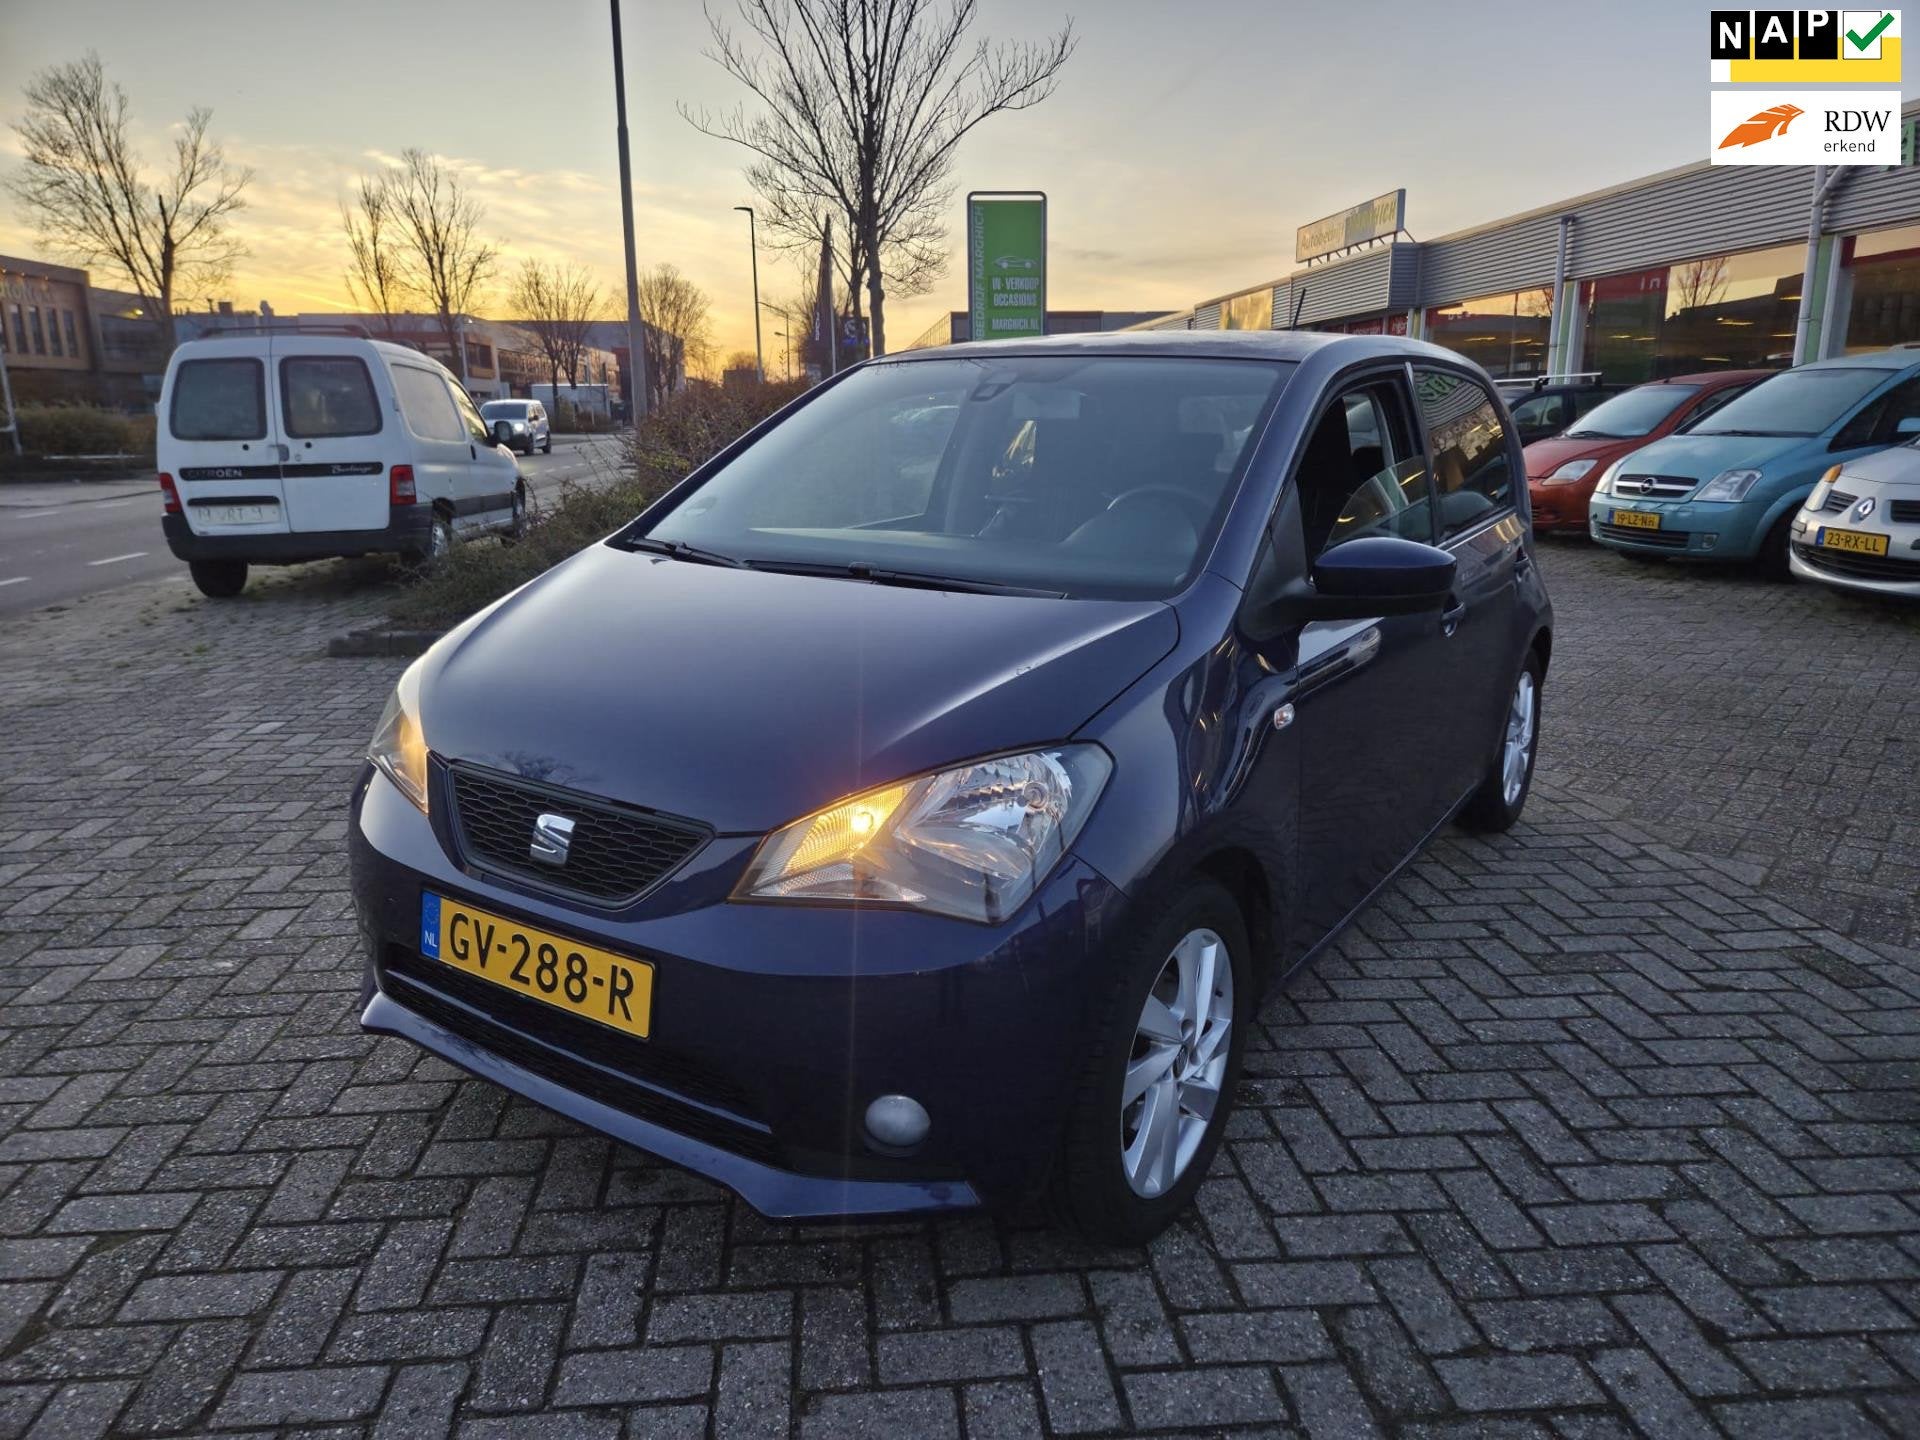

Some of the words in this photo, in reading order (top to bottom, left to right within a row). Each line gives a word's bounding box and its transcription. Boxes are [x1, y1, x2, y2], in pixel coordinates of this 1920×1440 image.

[1005, 277, 1040, 290] VERKOOP
[993, 293, 1037, 306] OCCASIONS
[1827, 532, 1879, 552] 23-RX-LL
[424, 931, 438, 948] NL
[449, 912, 634, 1022] GV-288-R
